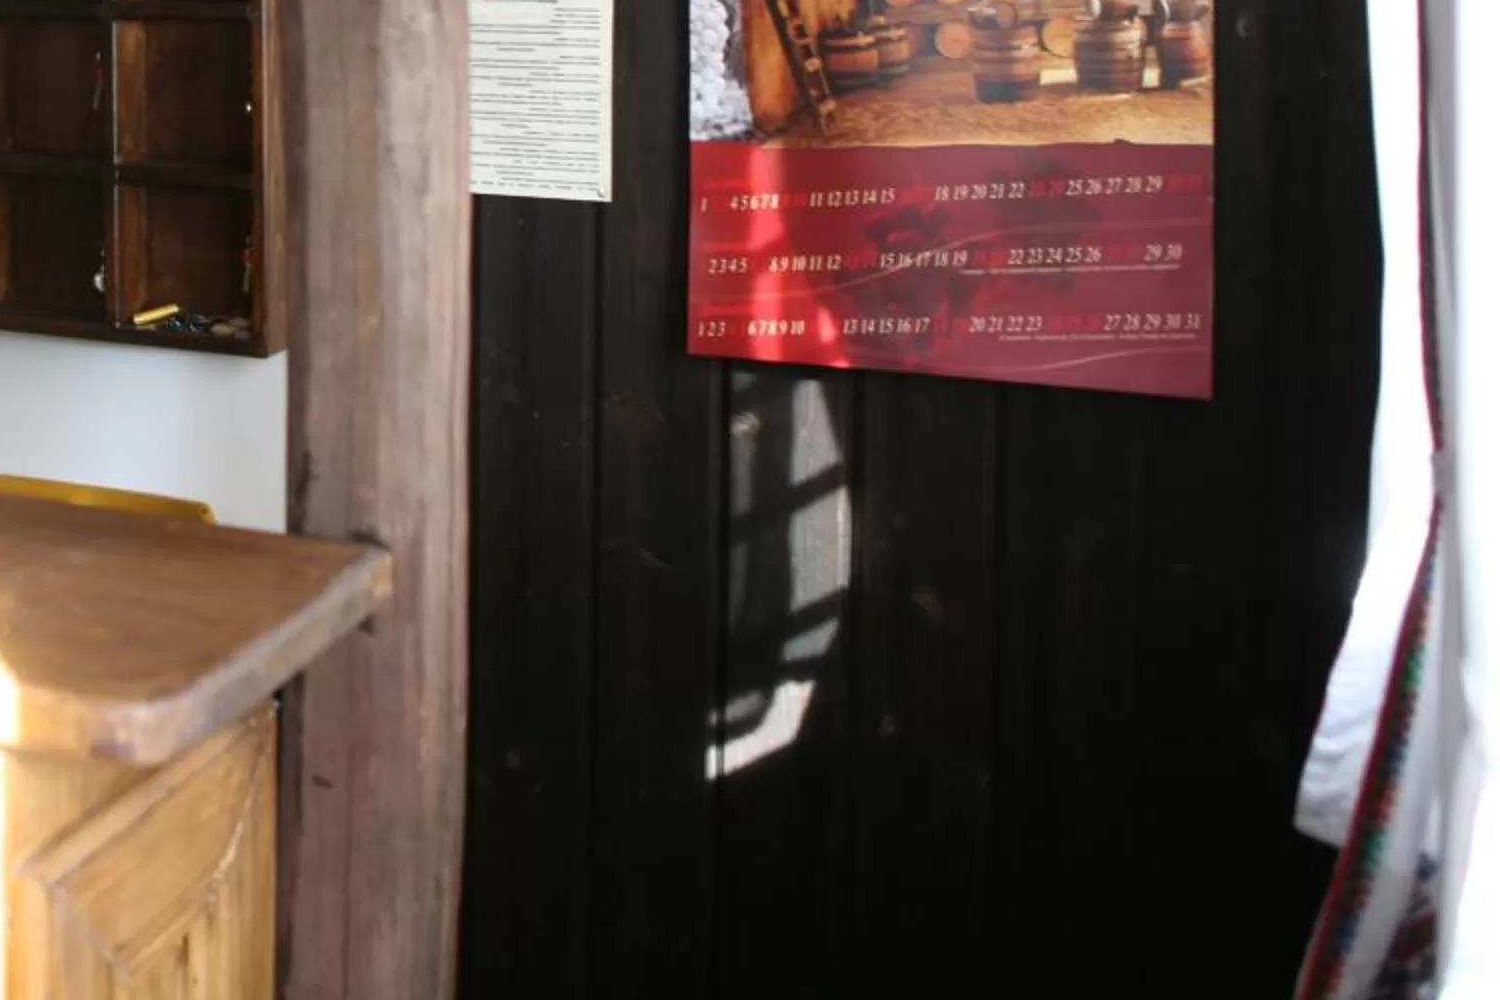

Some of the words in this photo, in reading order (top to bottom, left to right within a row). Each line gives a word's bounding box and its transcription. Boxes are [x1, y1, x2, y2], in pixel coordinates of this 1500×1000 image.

[810, 192, 823, 207] 11
[827, 191, 842, 207] 12
[845, 190, 859, 205] 13
[862, 188, 877, 205] 14
[880, 187, 896, 204] 15
[935, 185, 949, 200] 18
[953, 184, 969, 200] 19
[971, 184, 987, 200] 20
[989, 183, 1005, 199] 21
[1008, 182, 1025, 199] 22
[1066, 179, 1083, 196] 25
[1085, 178, 1102, 195] 26
[1105, 177, 1123, 195] 27
[1124, 176, 1142, 193] 28
[1145, 175, 1163, 193] 29
[792, 256, 807, 271] 10
[809, 255, 823, 271] 11
[827, 254, 842, 270] 12
[880, 253, 895, 268] 15
[898, 253, 912, 268] 16
[916, 252, 932, 268] 17
[933, 251, 949, 267] 18
[952, 251, 968, 267] 19
[1008, 249, 1024, 265] 22
[1027, 248, 1043, 264] 23
[1046, 248, 1063, 263] 24
[1065, 247, 1082, 263] 25
[1084, 246, 1102, 263] 26
[1145, 244, 1163, 261] 29
[1164, 243, 1183, 261] 30
[790, 320, 805, 335] 10
[843, 318, 858, 334] 13
[861, 318, 875, 334] 14
[879, 318, 894, 334] 15
[897, 317, 912, 333] 16
[915, 317, 931, 333] 17
[968, 316, 986, 333] 20
[988, 316, 1003, 333] 21
[1006, 316, 1023, 332] 22
[1026, 315, 1043, 332] 23
[1104, 314, 1121, 331] 27
[1123, 313, 1141, 331] 28
[1144, 313, 1162, 330] 29
[1163, 313, 1182, 330] 30
[1184, 313, 1202, 330] 31
